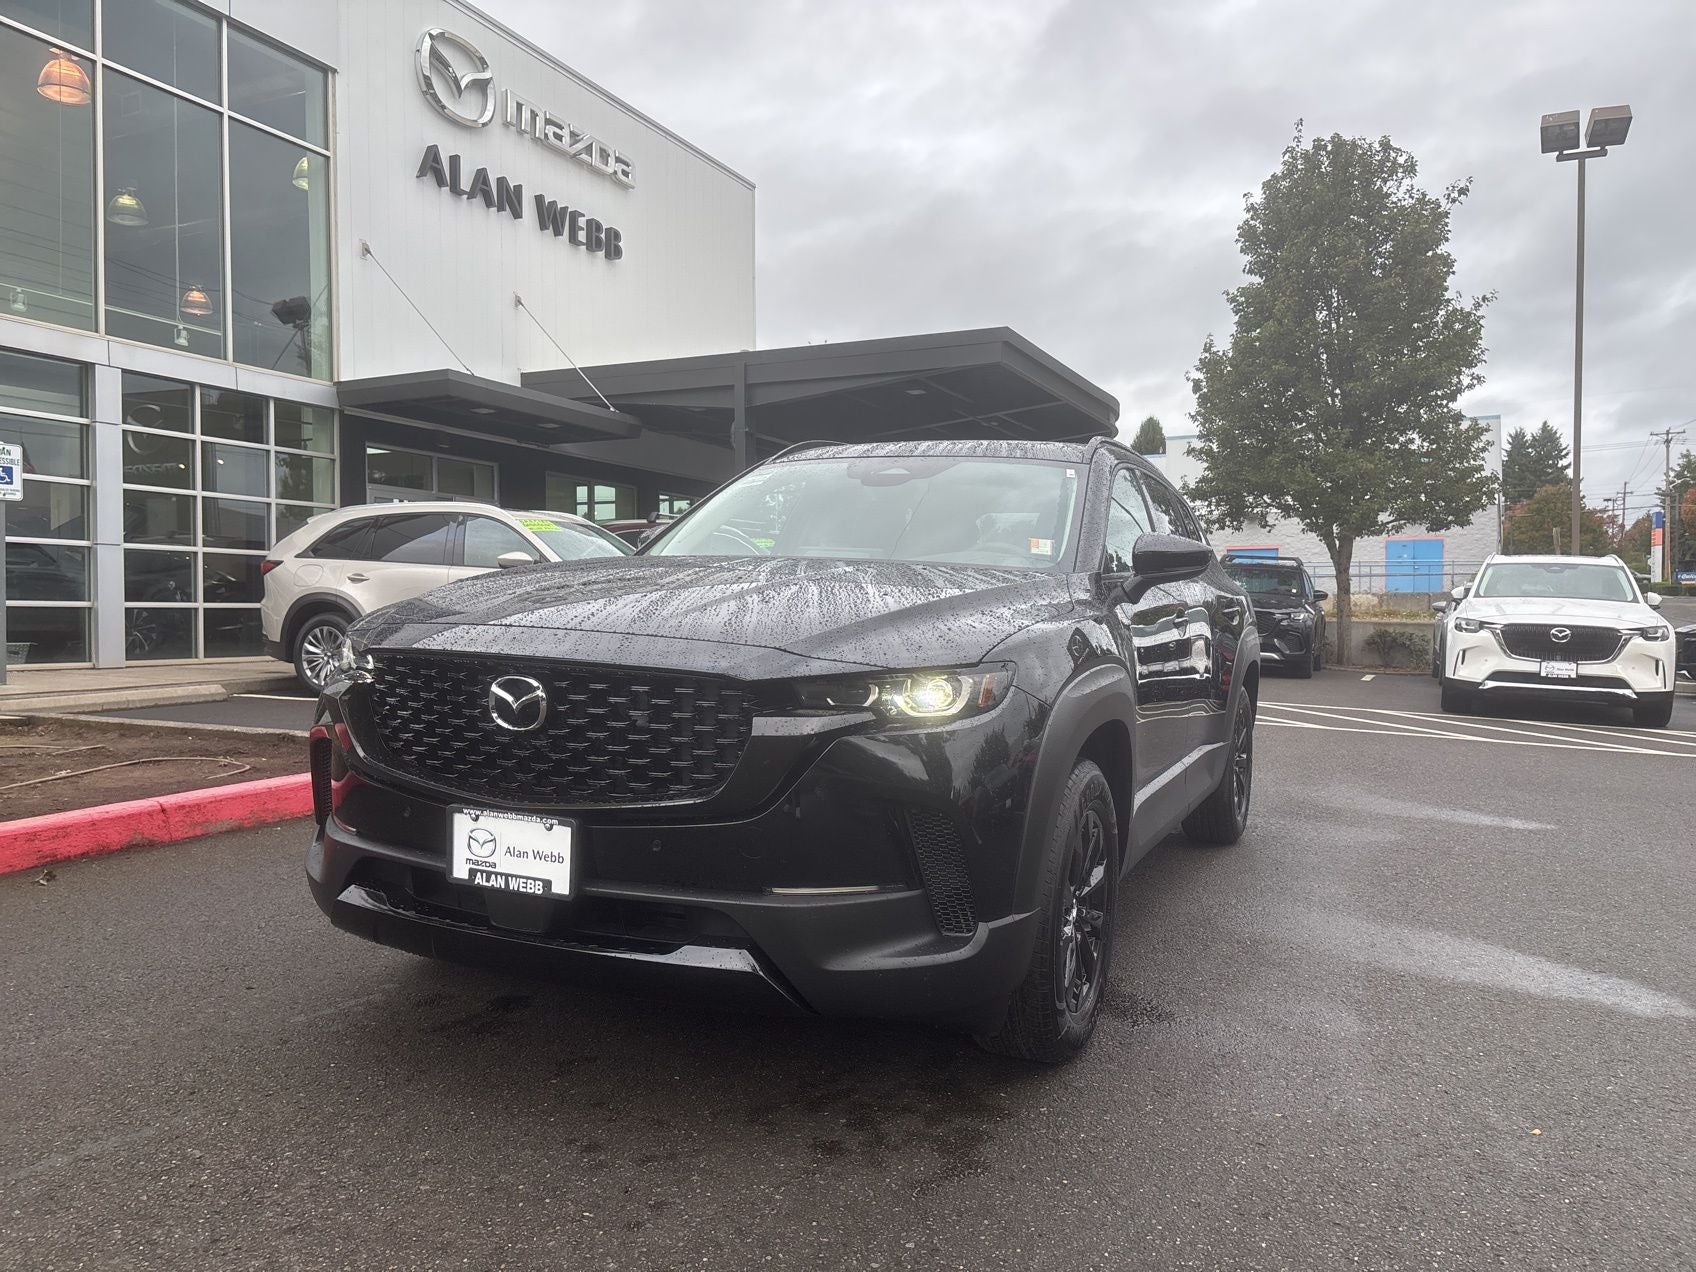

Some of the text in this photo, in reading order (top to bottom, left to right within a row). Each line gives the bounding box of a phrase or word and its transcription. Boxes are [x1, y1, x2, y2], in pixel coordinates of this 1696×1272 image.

[502, 87, 635, 190] mazda
[415, 143, 623, 260] ALAN WEBB
[465, 857, 497, 869] mazda
[504, 845, 565, 865] Alan Webb
[474, 871, 544, 894] ALAN WEBB
